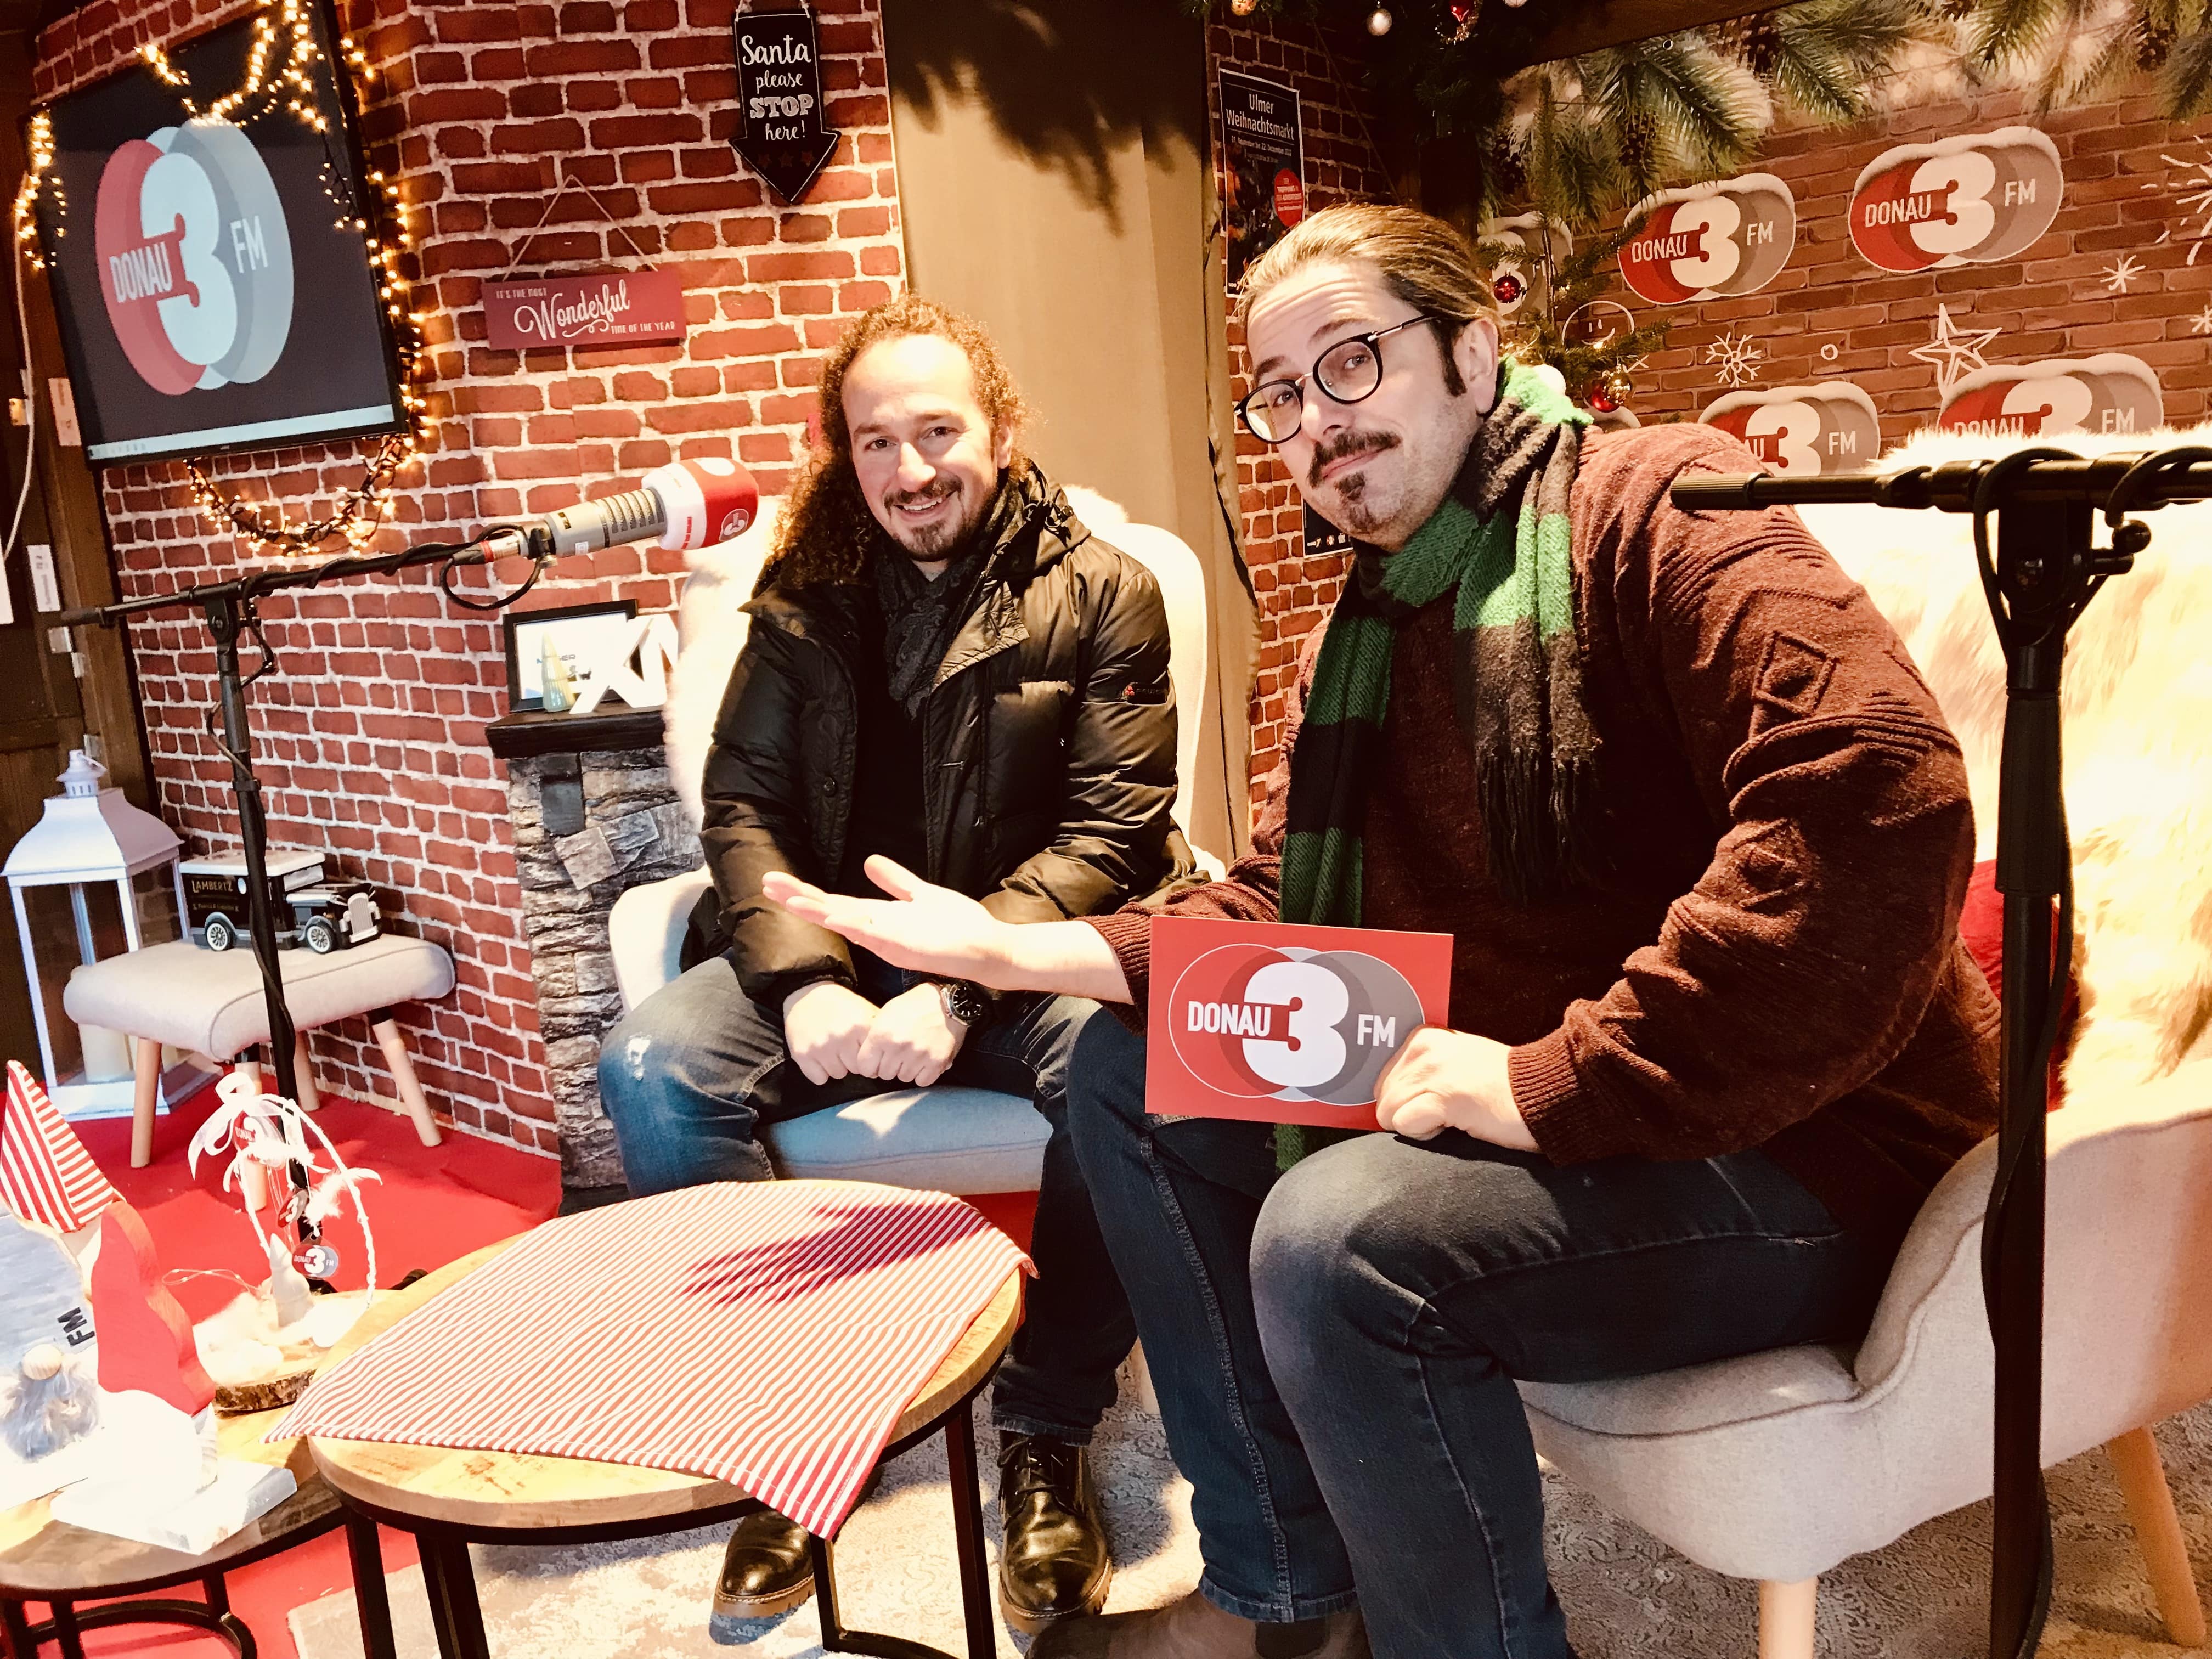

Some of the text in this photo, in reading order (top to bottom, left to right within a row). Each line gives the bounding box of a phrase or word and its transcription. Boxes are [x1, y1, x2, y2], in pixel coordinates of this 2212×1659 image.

[741, 34, 812, 65] Santa
[755, 70, 804, 94] please
[749, 93, 814, 119] STOP
[1249, 93, 1274, 115] Ulmer
[765, 120, 806, 140] here!
[1226, 108, 1294, 141] Weihnachtsmarkt
[1865, 151, 2036, 254] DONAU 3 FM
[1632, 196, 1774, 288] DONAU 3 FM
[110, 152, 268, 365] DONAU 3 FM
[514, 279, 630, 341] Wonderful
[628, 324, 638, 332] OF
[640, 323, 652, 332] THE
[654, 321, 676, 330] YEAR
[2102, 407, 2135, 435] FM
[1745, 400, 1821, 477] 3
[1829, 431, 1857, 455] FM
[191, 879, 233, 893] LAMBERTZ
[1187, 961, 1396, 1087] DONAU 3 FM
[304, 1248, 325, 1273] 3
[57, 1307, 95, 1347] FM
